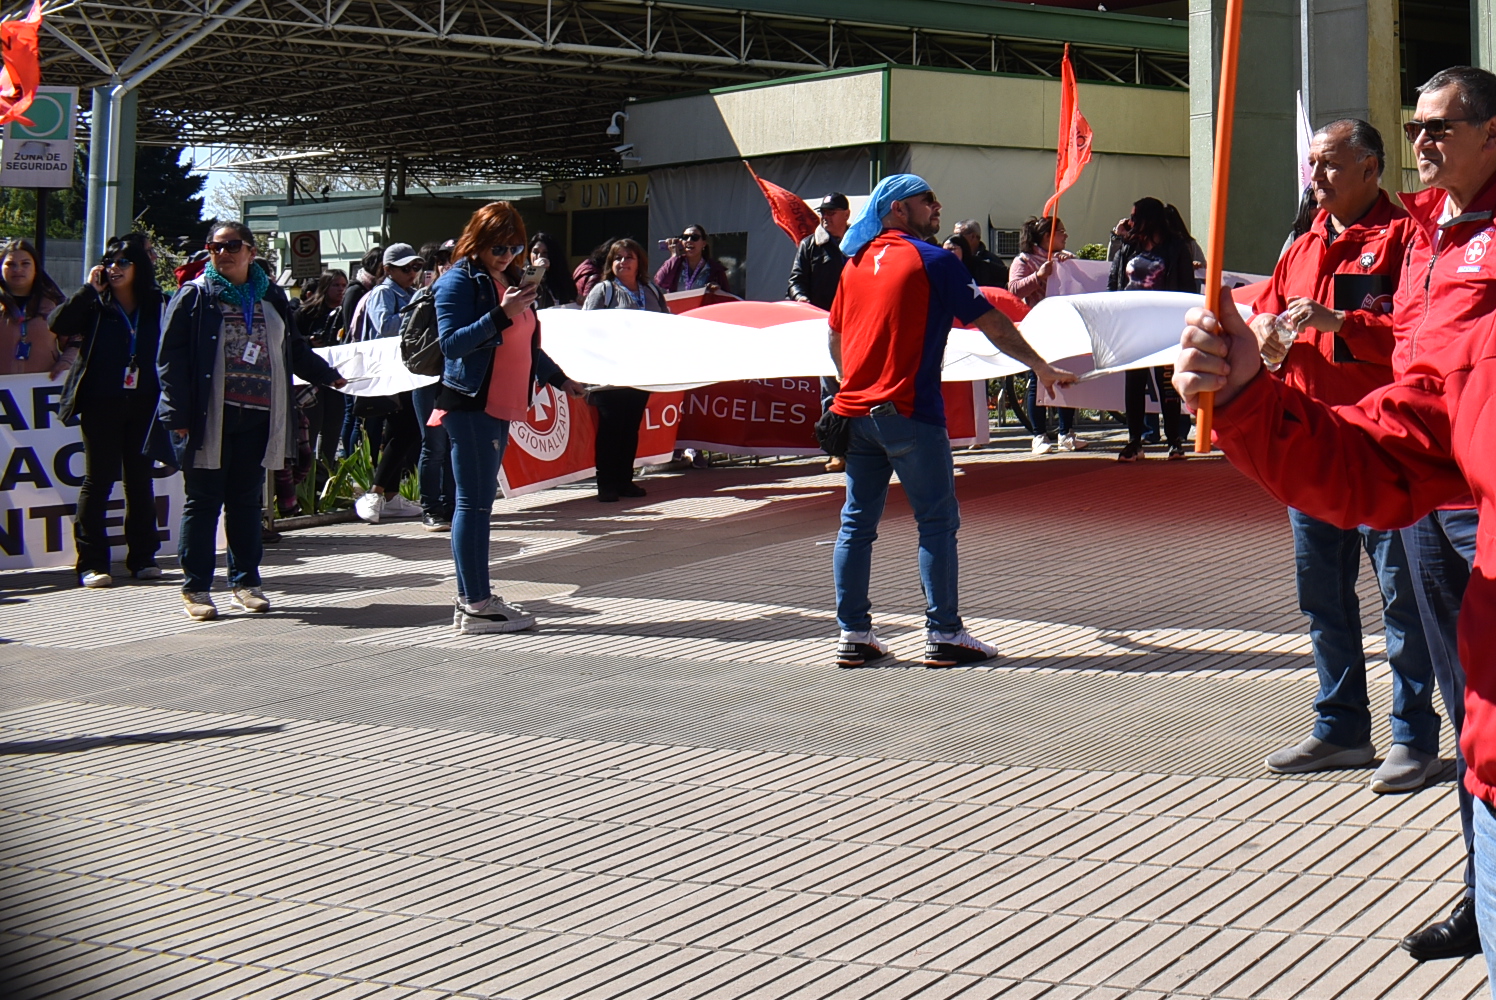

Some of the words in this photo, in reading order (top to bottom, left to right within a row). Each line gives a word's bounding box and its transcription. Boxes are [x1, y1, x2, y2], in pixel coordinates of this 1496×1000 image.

[47, 152, 61, 162] DE
[5, 161, 68, 171] SEGURIDAD
[300, 236, 311, 253] E
[782, 377, 816, 393] DR.
[682, 393, 807, 425] NGELES
[511, 394, 567, 453] EGIONALIZADA
